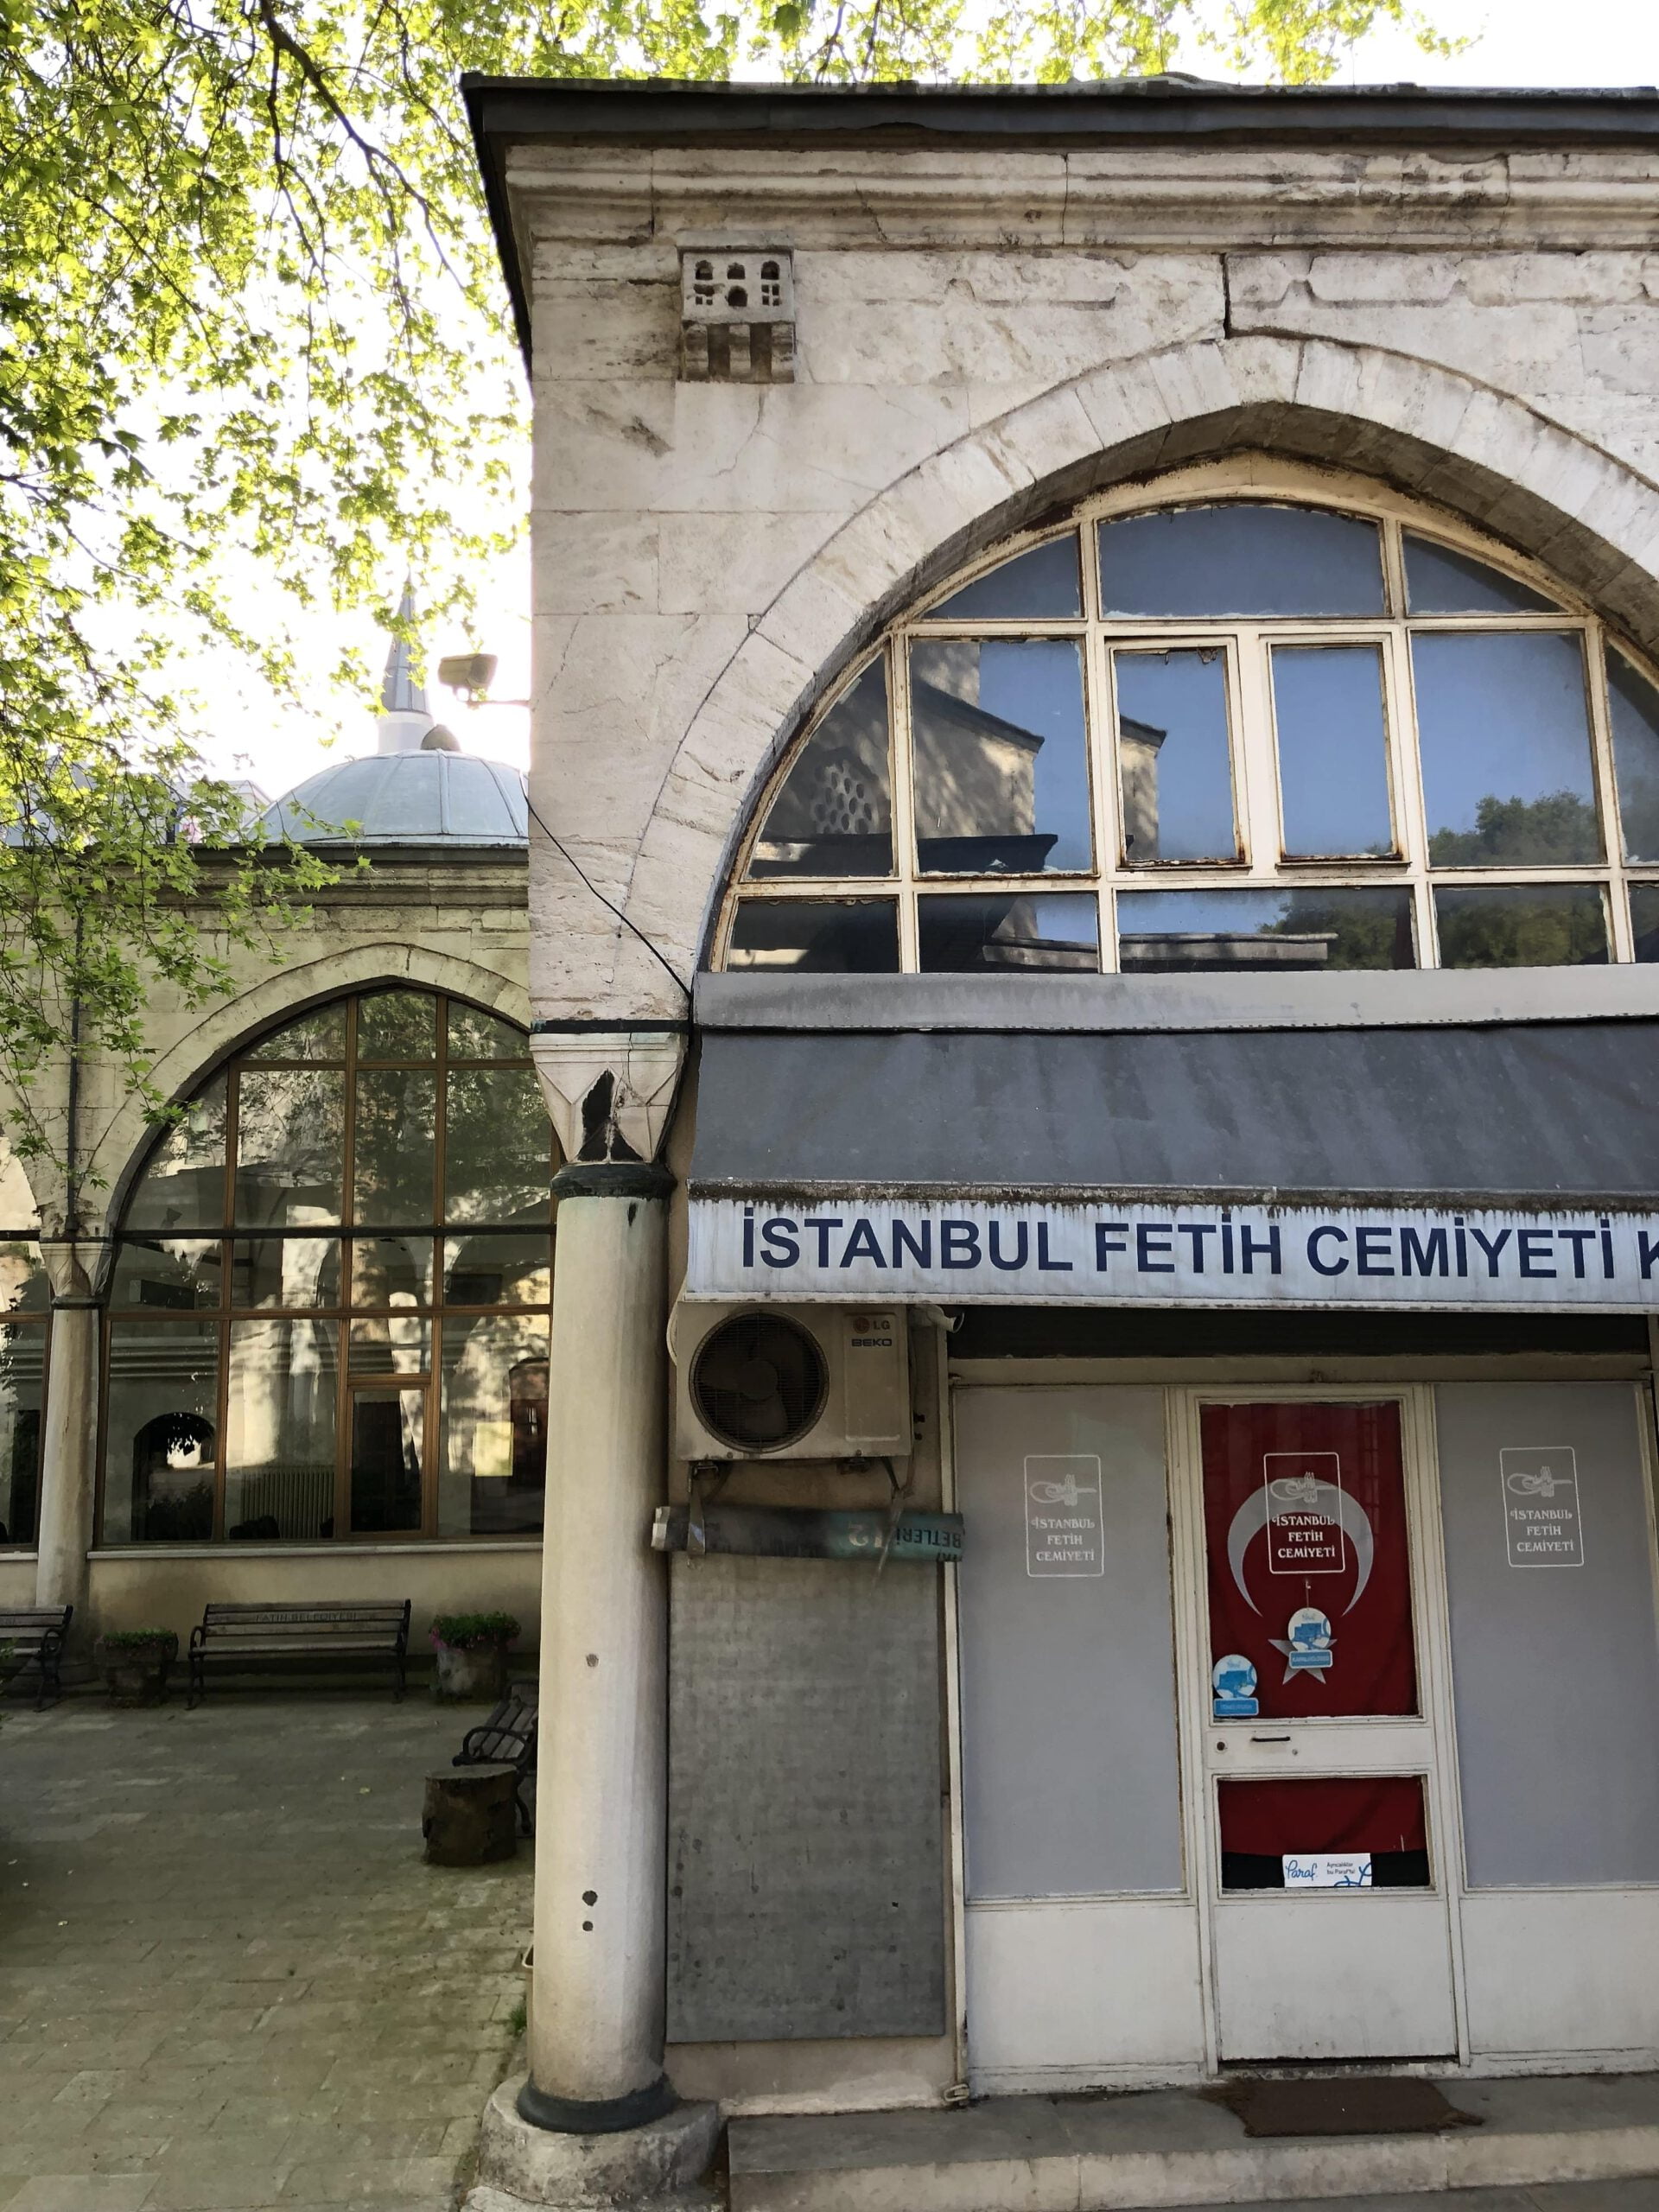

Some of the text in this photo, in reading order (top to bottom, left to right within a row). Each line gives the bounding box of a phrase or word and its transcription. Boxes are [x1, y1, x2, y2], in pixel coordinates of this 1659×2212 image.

[743, 1207, 1073, 1271] İSTANBUL
[1096, 1213, 1282, 1274] FETİH
[1306, 1217, 1615, 1279] CEMİYETİ
[873, 1320, 891, 1332] LG
[851, 1338, 893, 1347] BEKO
[1271, 1514, 1334, 1526] İSTANBUL
[1288, 1529, 1324, 1541] FETİH
[1527, 1523, 1561, 1535] FETİH
[1047, 1533, 1083, 1545] FETİH
[1278, 1545, 1335, 1558] CEMİYETİ
[1516, 1539, 1574, 1552] CEMİYETİ
[1036, 1548, 1095, 1561] CEMİYETİ
[1285, 1859, 1318, 1881] Paraf
